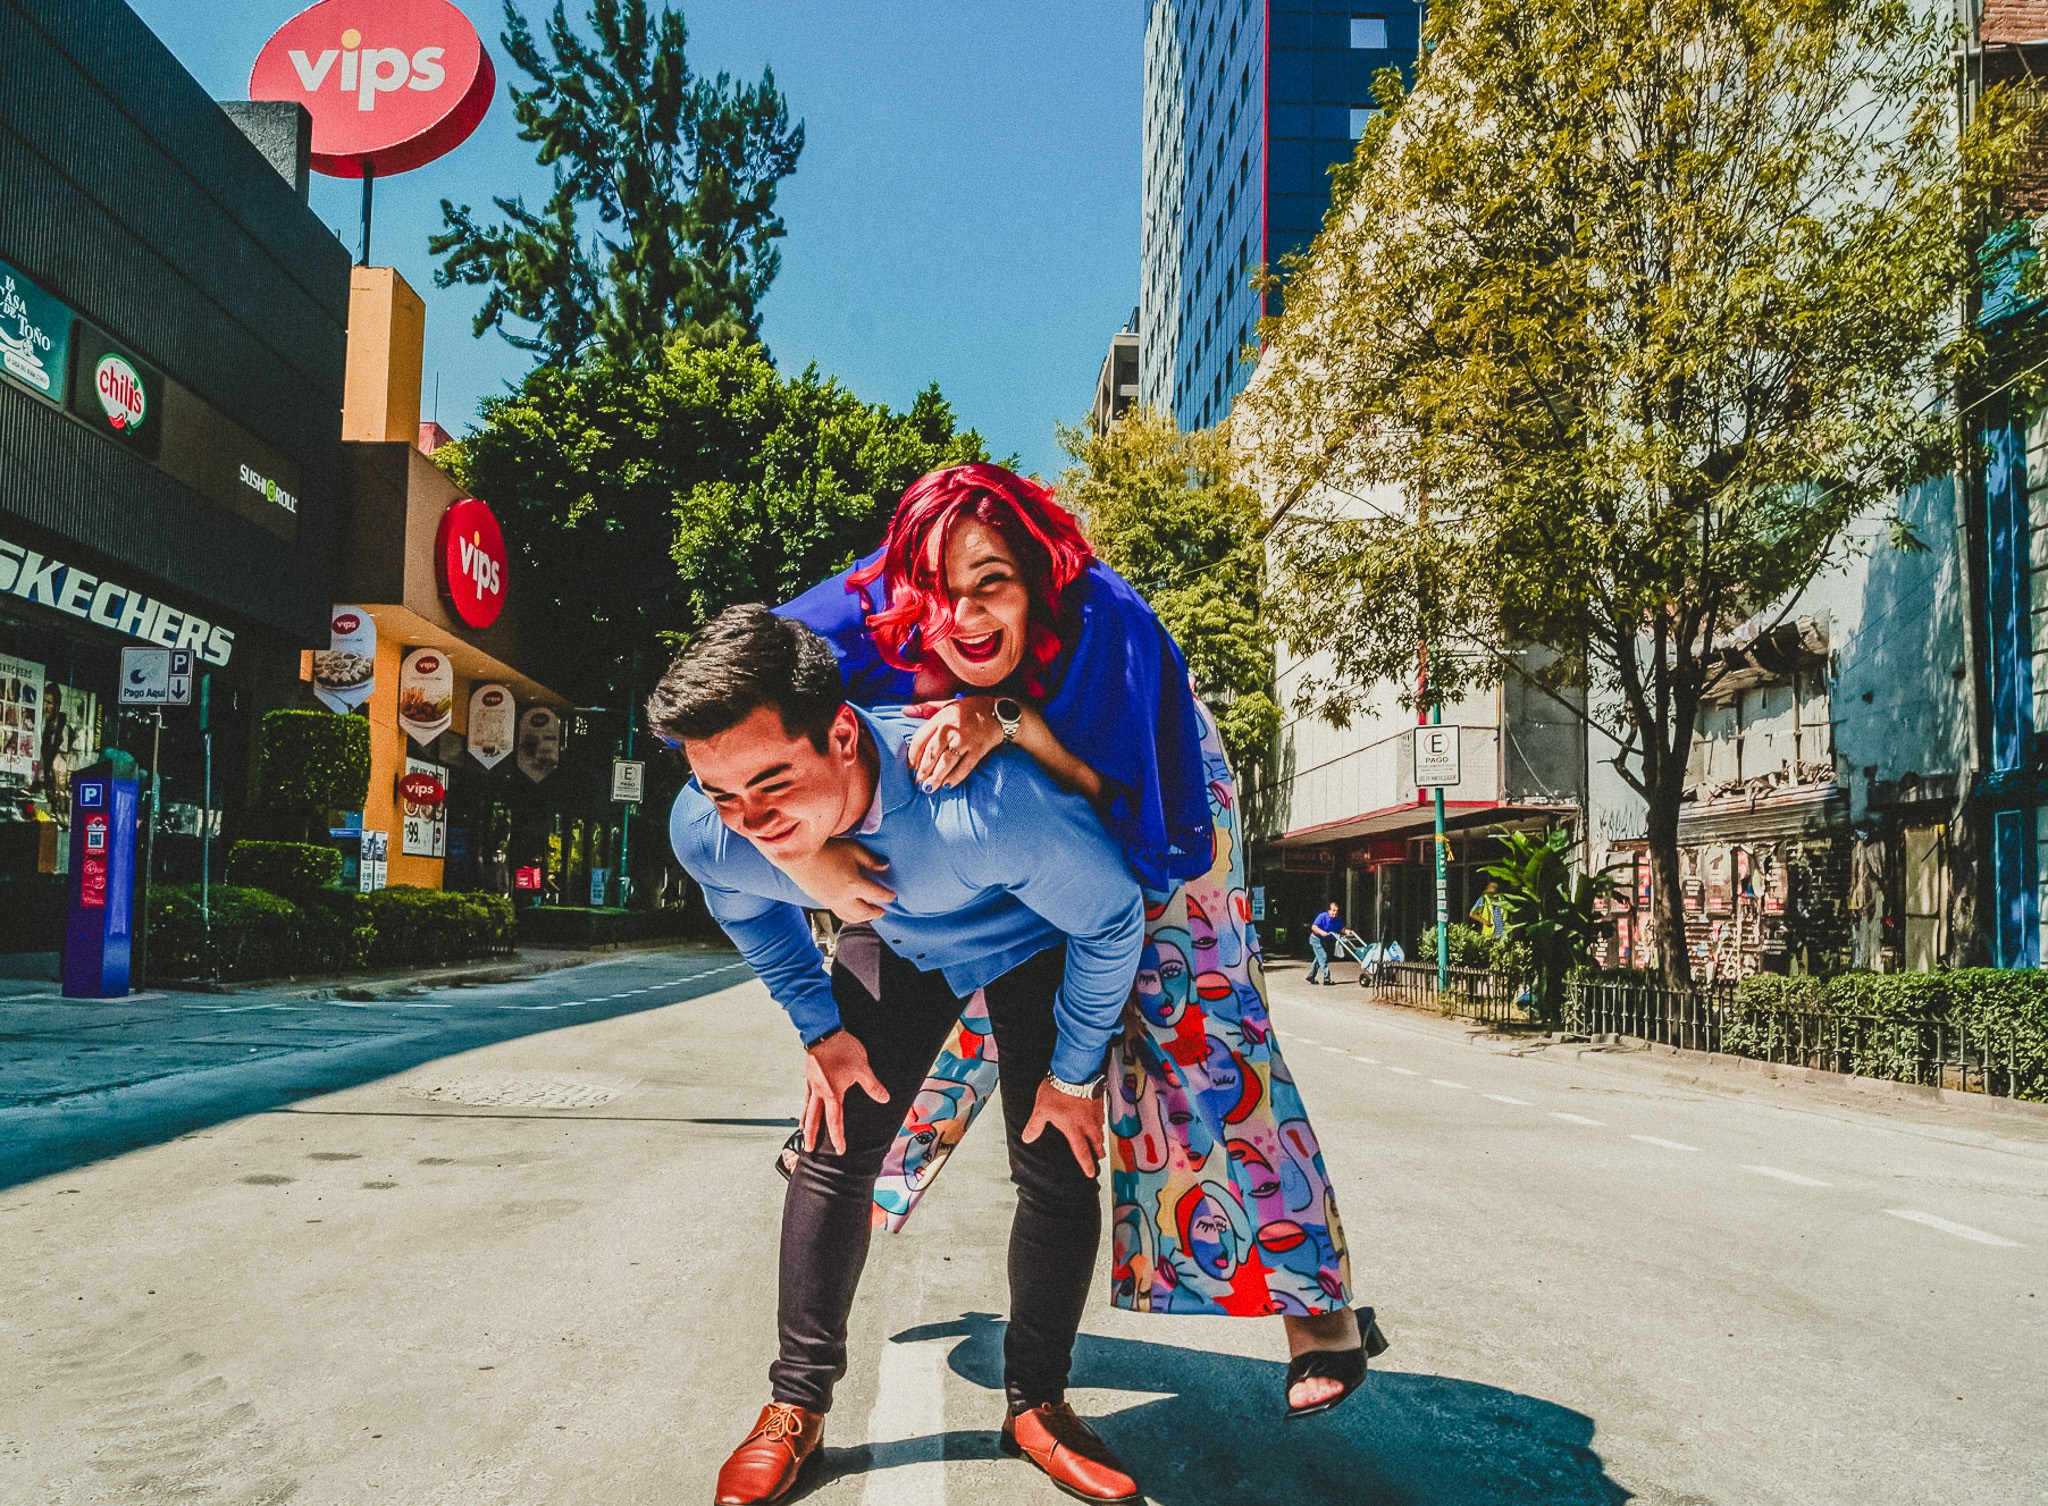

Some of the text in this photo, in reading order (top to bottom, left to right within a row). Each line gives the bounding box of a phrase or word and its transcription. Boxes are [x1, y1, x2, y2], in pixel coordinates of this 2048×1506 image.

[287, 28, 446, 112] vips
[5, 275, 16, 291] LA
[3, 302, 17, 319] DE
[459, 530, 500, 600] vips
[0, 538, 235, 667] SKECHERS
[336, 621, 357, 630] vips
[174, 654, 187, 672] P
[124, 687, 145, 699] Pago
[1431, 733, 1443, 753] E
[624, 767, 633, 781] E
[84, 787, 98, 803] P
[406, 782, 435, 798] vips
